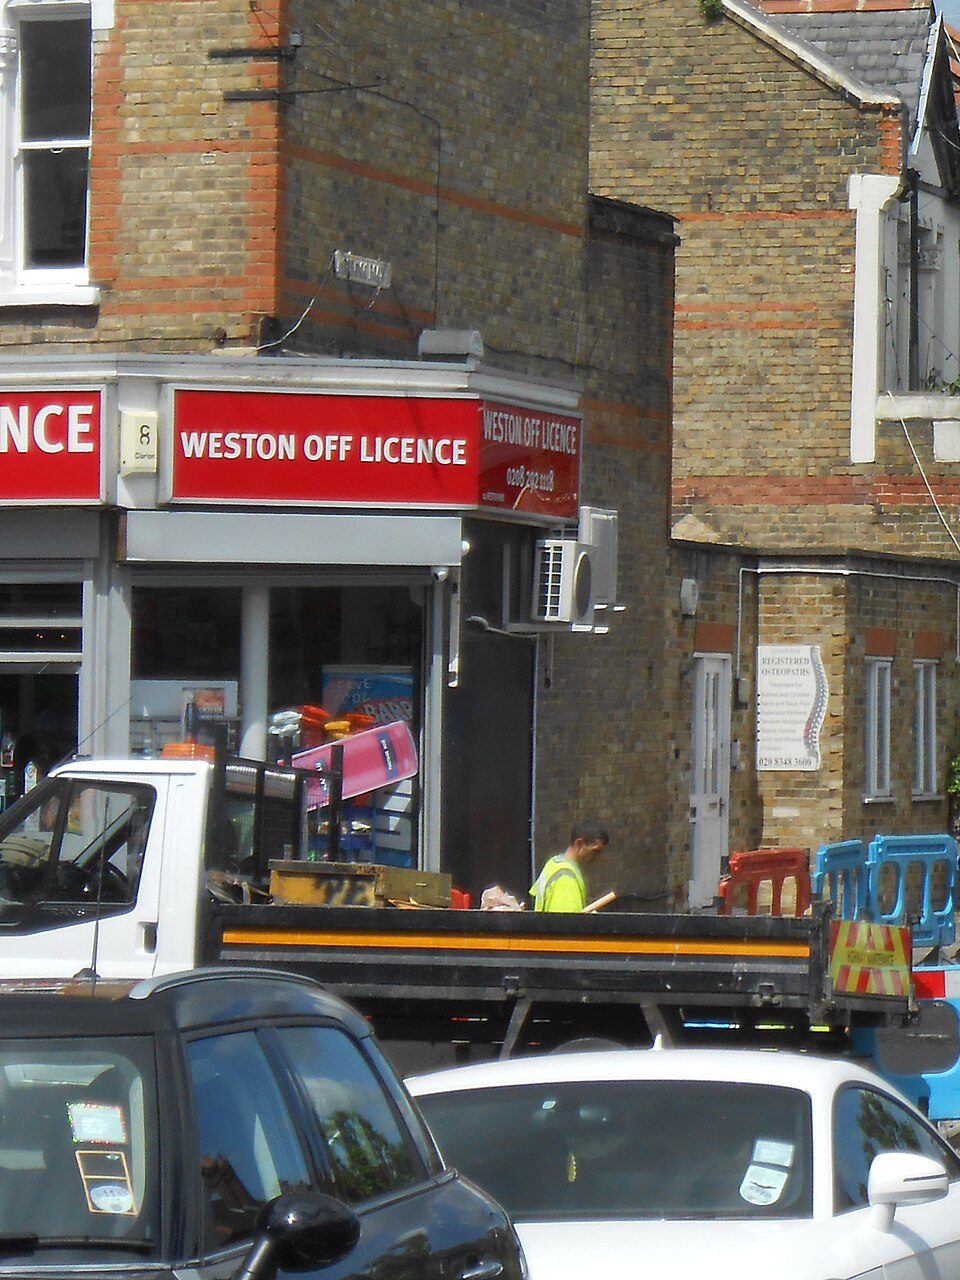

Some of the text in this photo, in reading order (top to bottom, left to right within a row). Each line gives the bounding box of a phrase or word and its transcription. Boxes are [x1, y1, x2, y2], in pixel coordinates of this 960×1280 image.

[0, 405, 94, 453] NCE
[483, 410, 577, 455] WESTON OFF LICENCE
[180, 431, 468, 465] WESTON OFF LICENCE
[506, 465, 525, 488] 0208
[761, 657, 810, 665] REGISTERED
[761, 668, 810, 676] OSTEOPATHS
[758, 757, 773, 767] 020
[774, 757, 792, 767] 8348
